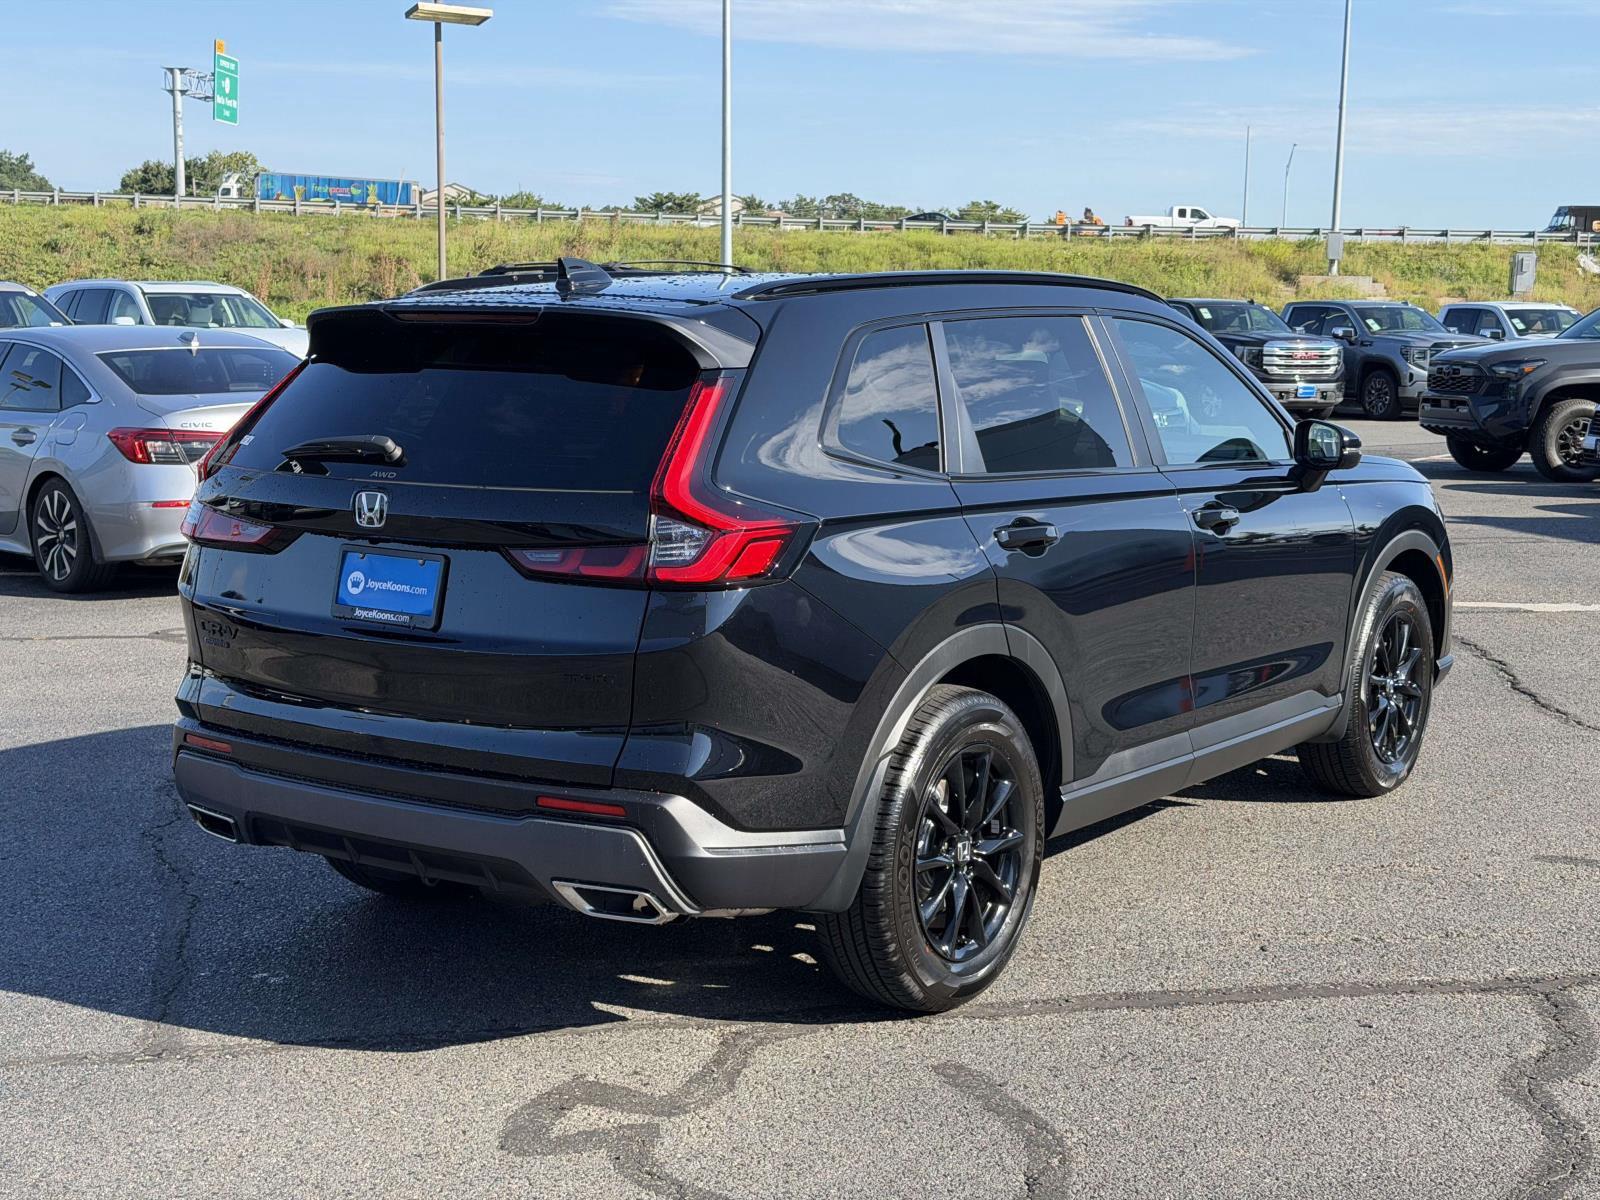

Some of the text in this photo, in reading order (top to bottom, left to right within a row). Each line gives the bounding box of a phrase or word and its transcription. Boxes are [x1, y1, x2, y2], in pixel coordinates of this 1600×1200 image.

[369, 470, 397, 478] AWD
[366, 579, 427, 595] JoyceKoons.com
[354, 608, 410, 623] JoyceKoons.com
